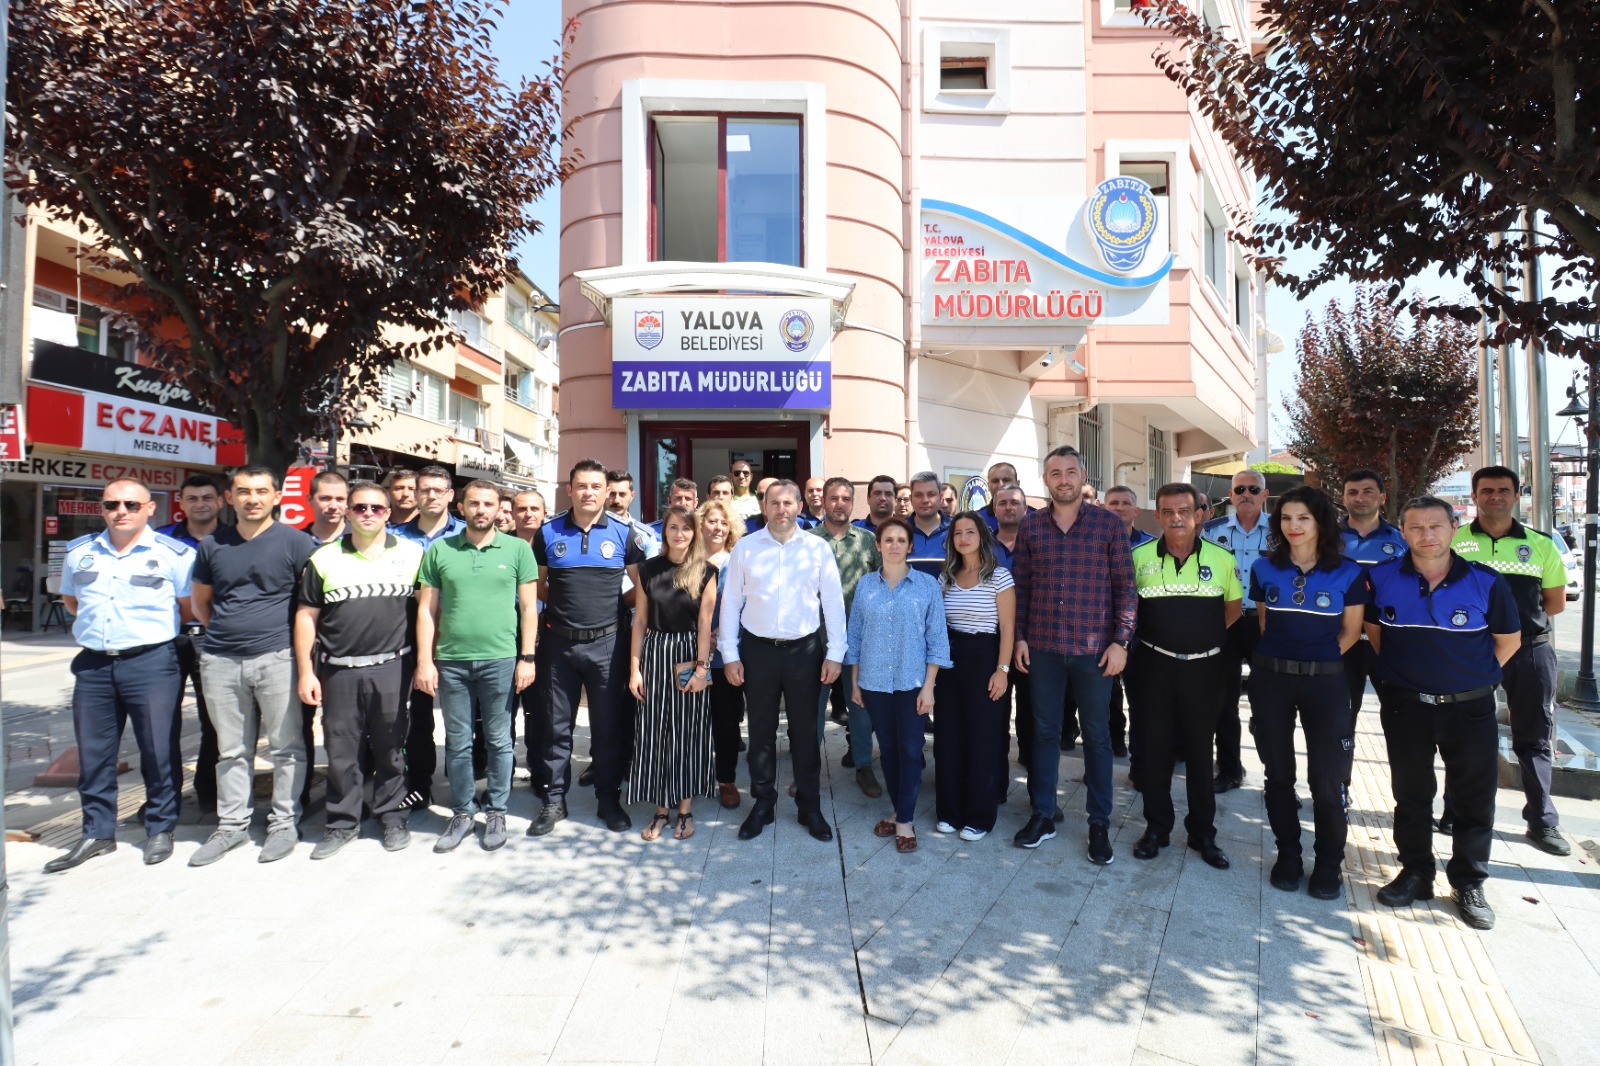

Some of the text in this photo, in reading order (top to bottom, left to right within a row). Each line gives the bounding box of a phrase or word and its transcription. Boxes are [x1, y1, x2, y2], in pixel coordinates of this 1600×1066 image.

[1101, 179, 1145, 195] ZABITA
[924, 224, 942, 233] T.C.
[924, 236, 964, 245] YALOVA
[924, 246, 985, 257] BELEDİYESİ
[934, 259, 1032, 283] ZABITA
[934, 290, 1103, 318] MÜDÜRLÜĞÜ
[680, 311, 763, 330] YALOVA
[680, 334, 763, 351] BELEDİYESİ
[115, 366, 192, 404] Kuaför
[621, 371, 693, 392] ZABITA
[698, 369, 822, 392] MÜDÜRLÜĞÜ
[96, 401, 212, 443] ECZANE
[133, 439, 180, 454] MERKEZ
[91, 463, 177, 486] ECZANESİ
